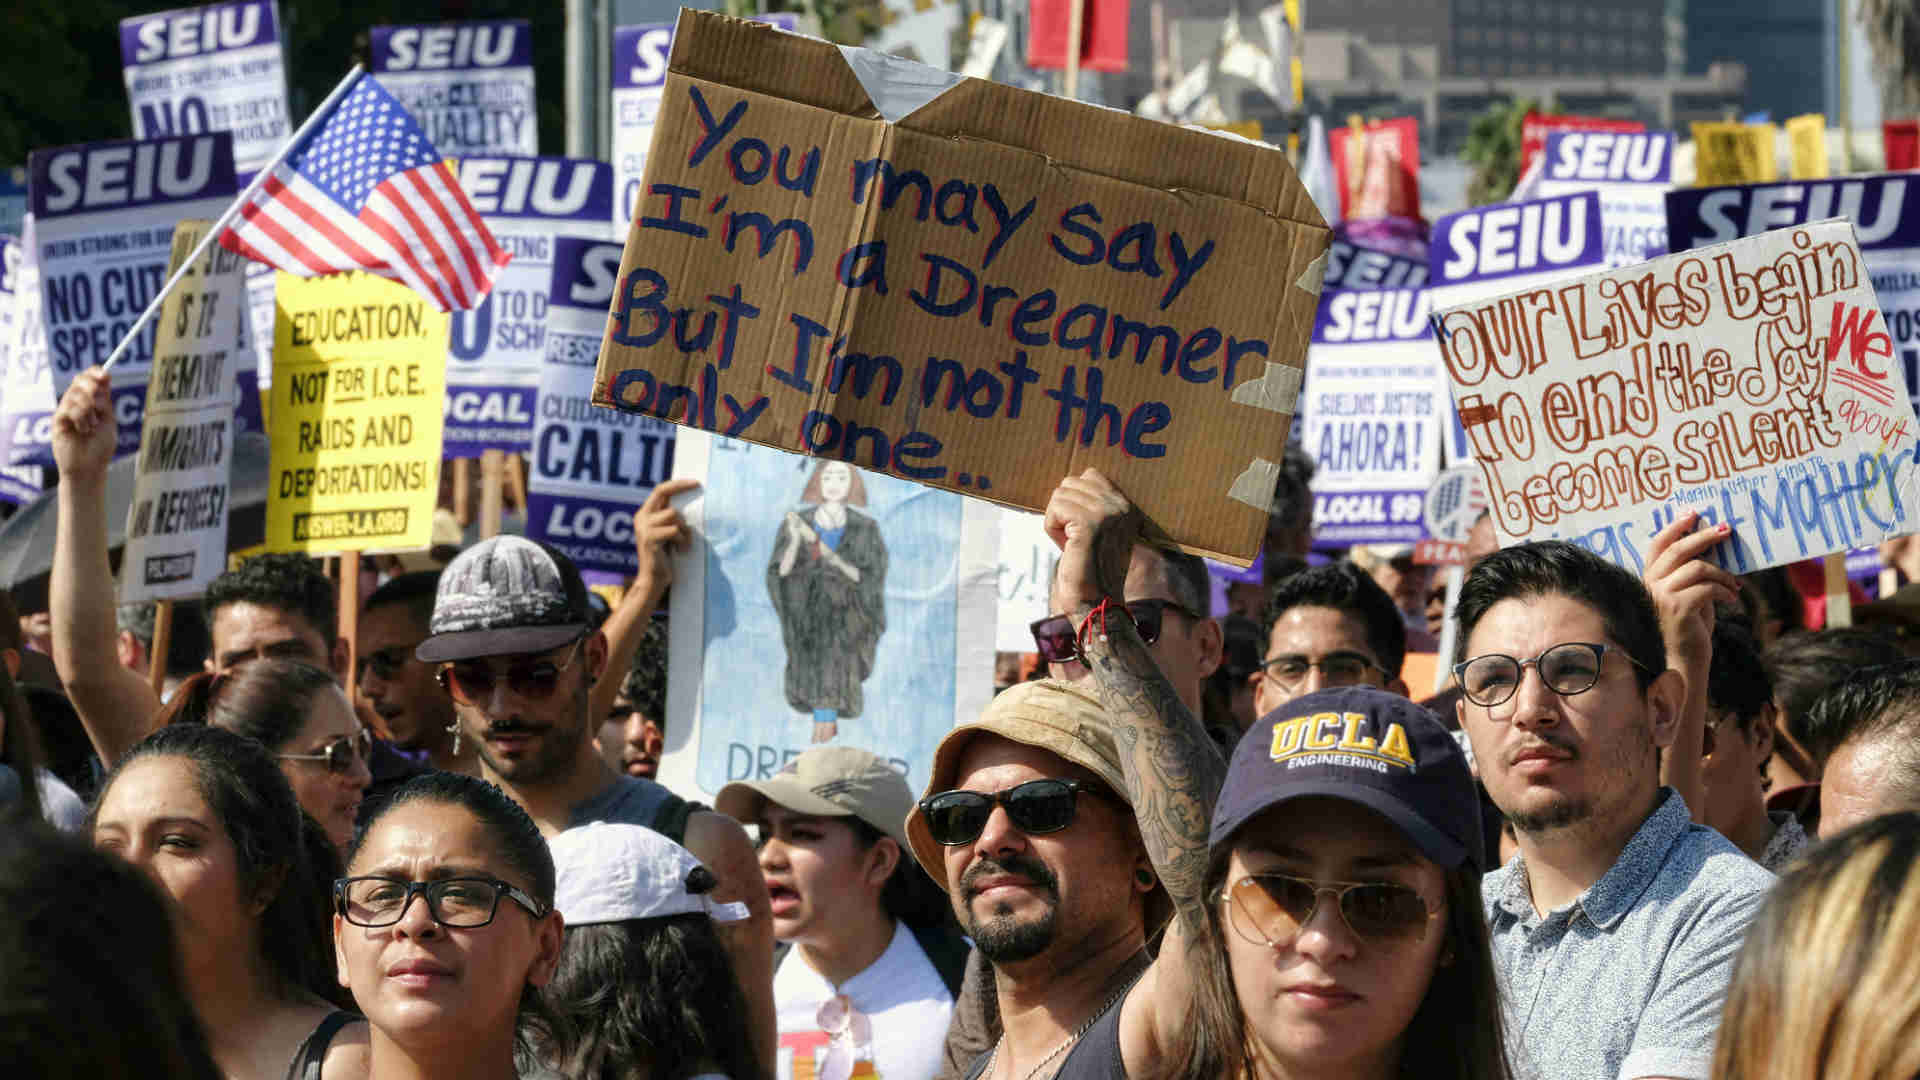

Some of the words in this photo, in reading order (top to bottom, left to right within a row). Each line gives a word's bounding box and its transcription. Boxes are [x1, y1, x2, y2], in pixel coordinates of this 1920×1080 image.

[137, 3, 261, 62] SEIU
[386, 25, 516, 71] SEIU
[424, 106, 525, 147] UALITY
[46, 136, 214, 212] SEIU
[1553, 133, 1667, 181] SEIU
[459, 158, 597, 215] EIU
[688, 86, 821, 198] You
[850, 158, 1037, 270] may
[1048, 203, 1215, 311] say
[1444, 197, 1588, 280] SEIU
[47, 271, 94, 326] NO
[101, 263, 166, 318] CUT
[636, 183, 814, 278] I'm
[835, 240, 888, 295] a
[908, 252, 1269, 391] Dreamer
[1559, 258, 1712, 360] Lives
[1712, 230, 1859, 350] begin
[53, 316, 160, 373] SPECI
[496, 323, 547, 350] SCH
[1323, 290, 1432, 342] SEIU
[1827, 301, 1894, 380] We
[290, 370, 329, 407] NOT
[334, 367, 366, 393] FOR
[609, 267, 761, 370] But
[766, 313, 904, 407] I'm
[920, 349, 1041, 420] not
[1043, 366, 1171, 459] the
[1541, 341, 1659, 454] end
[1655, 341, 1735, 413] the
[1737, 318, 1830, 411] day
[448, 391, 530, 423] CAL
[607, 361, 771, 438] only
[1838, 399, 1912, 451] about
[298, 418, 354, 454] RAIDS
[362, 415, 413, 448] AND
[536, 423, 677, 488] CALI
[1318, 421, 1424, 472] AHORA!
[279, 460, 428, 500] DEPORTATIONS!
[1476, 444, 1673, 537] become
[547, 504, 637, 544] LOC
[1313, 495, 1387, 524] LOCAL
[1390, 494, 1423, 523] 99
[1270, 711, 1417, 768] UCLA
[1286, 752, 1389, 774] ENGINEERING
